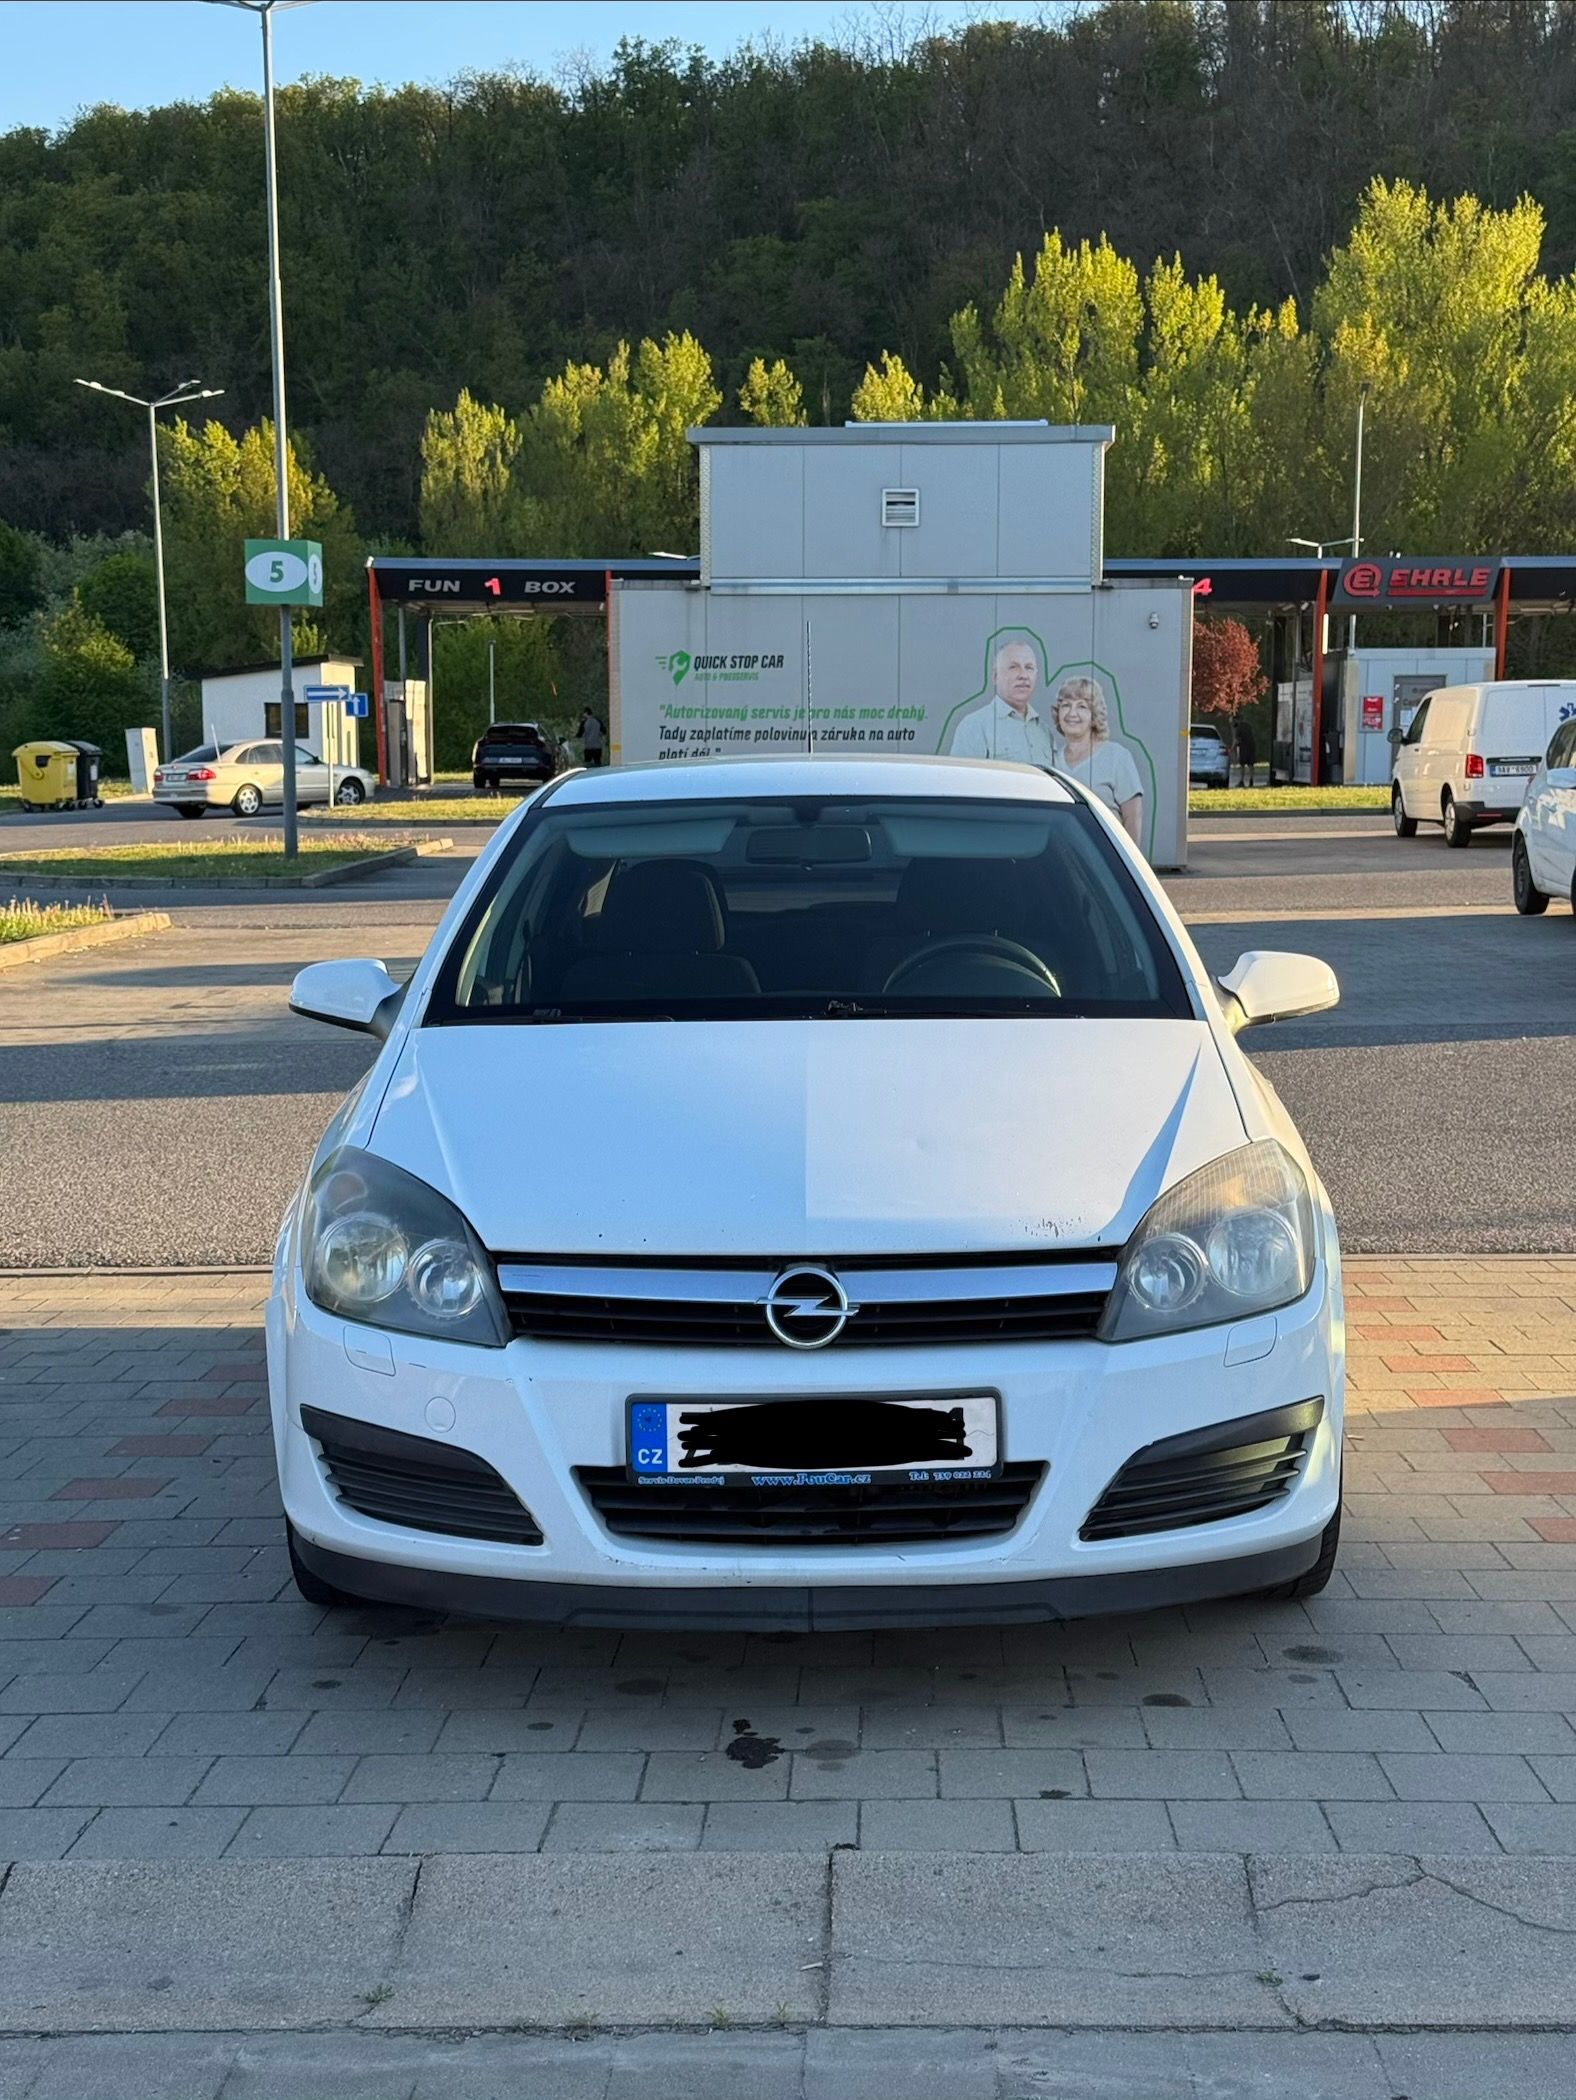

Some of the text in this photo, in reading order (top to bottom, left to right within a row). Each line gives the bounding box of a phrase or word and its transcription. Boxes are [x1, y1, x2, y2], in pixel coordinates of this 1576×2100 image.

[270, 560, 284, 583] 5
[1390, 567, 1491, 586] EHRLE
[408, 577, 575, 595] FUN 1 BOX
[1193, 578, 1212, 595] 4
[693, 654, 784, 671] QUICK STOP CAR
[660, 704, 748, 721] "Autorizovaný
[751, 706, 791, 719] servis
[793, 705, 806, 721] je
[833, 705, 856, 719] nás
[859, 708, 885, 719] moc
[887, 704, 928, 722] drahý.
[659, 725, 687, 742] Tady
[689, 726, 752, 742] zaplatíme
[754, 726, 807, 743] polovinu
[821, 726, 865, 741] záruka
[868, 730, 884, 741] na
[887, 728, 916, 741] auto
[658, 747, 689, 760] platí
[637, 1448, 663, 1465] CZ
